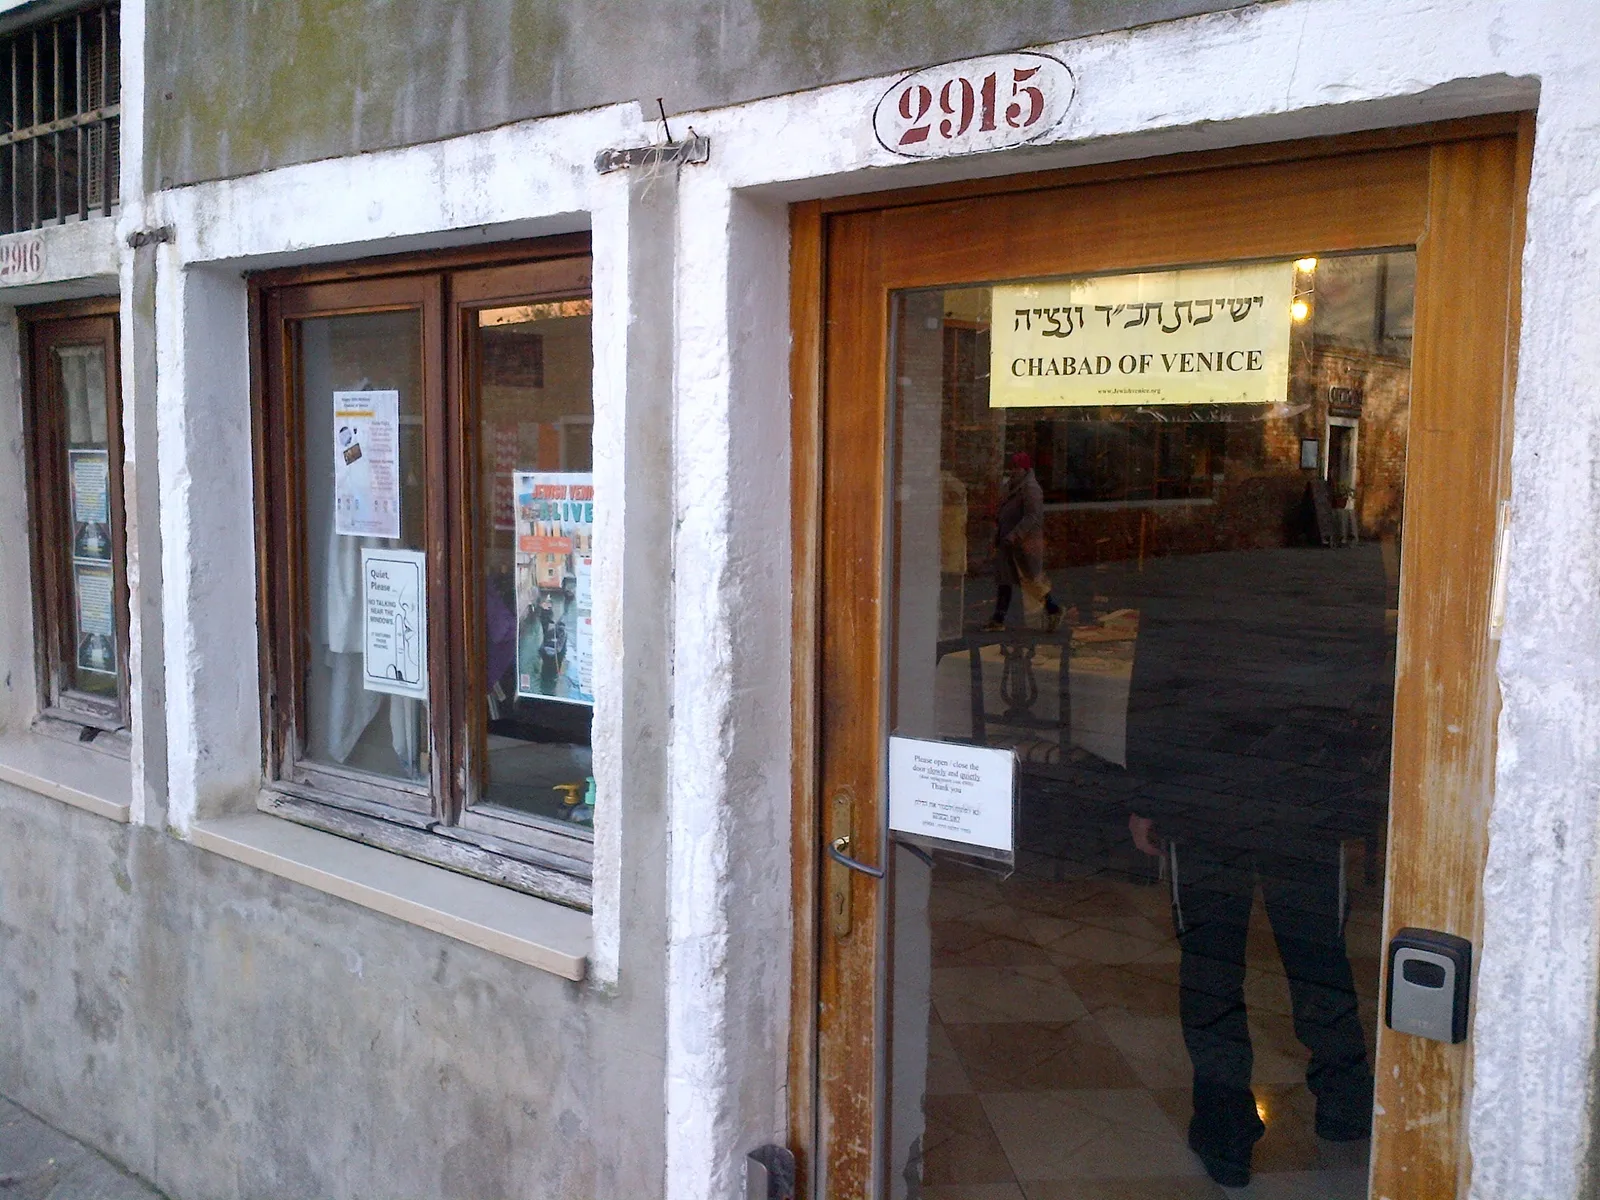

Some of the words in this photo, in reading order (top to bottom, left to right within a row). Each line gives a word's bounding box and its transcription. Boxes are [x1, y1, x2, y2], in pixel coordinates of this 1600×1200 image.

[898, 65, 1045, 146] 2915
[0, 240, 40, 275] 2916
[1014, 307, 1084, 338] ונציה
[1162, 296, 1264, 334] ישיבת
[1011, 355, 1112, 377] CHABAD
[1118, 354, 1154, 375] OF
[1160, 350, 1264, 373] VENICE
[532, 484, 567, 500] JEWISH
[370, 607, 384, 615] NEAR
[376, 600, 396, 608] TALKING
[912, 764, 926, 772] door
[927, 766, 946, 777] slowly
[914, 755, 933, 764] Please
[934, 759, 948, 767] open
[953, 761, 968, 769] close
[970, 762, 979, 771] the
[931, 782, 949, 792] Thank
